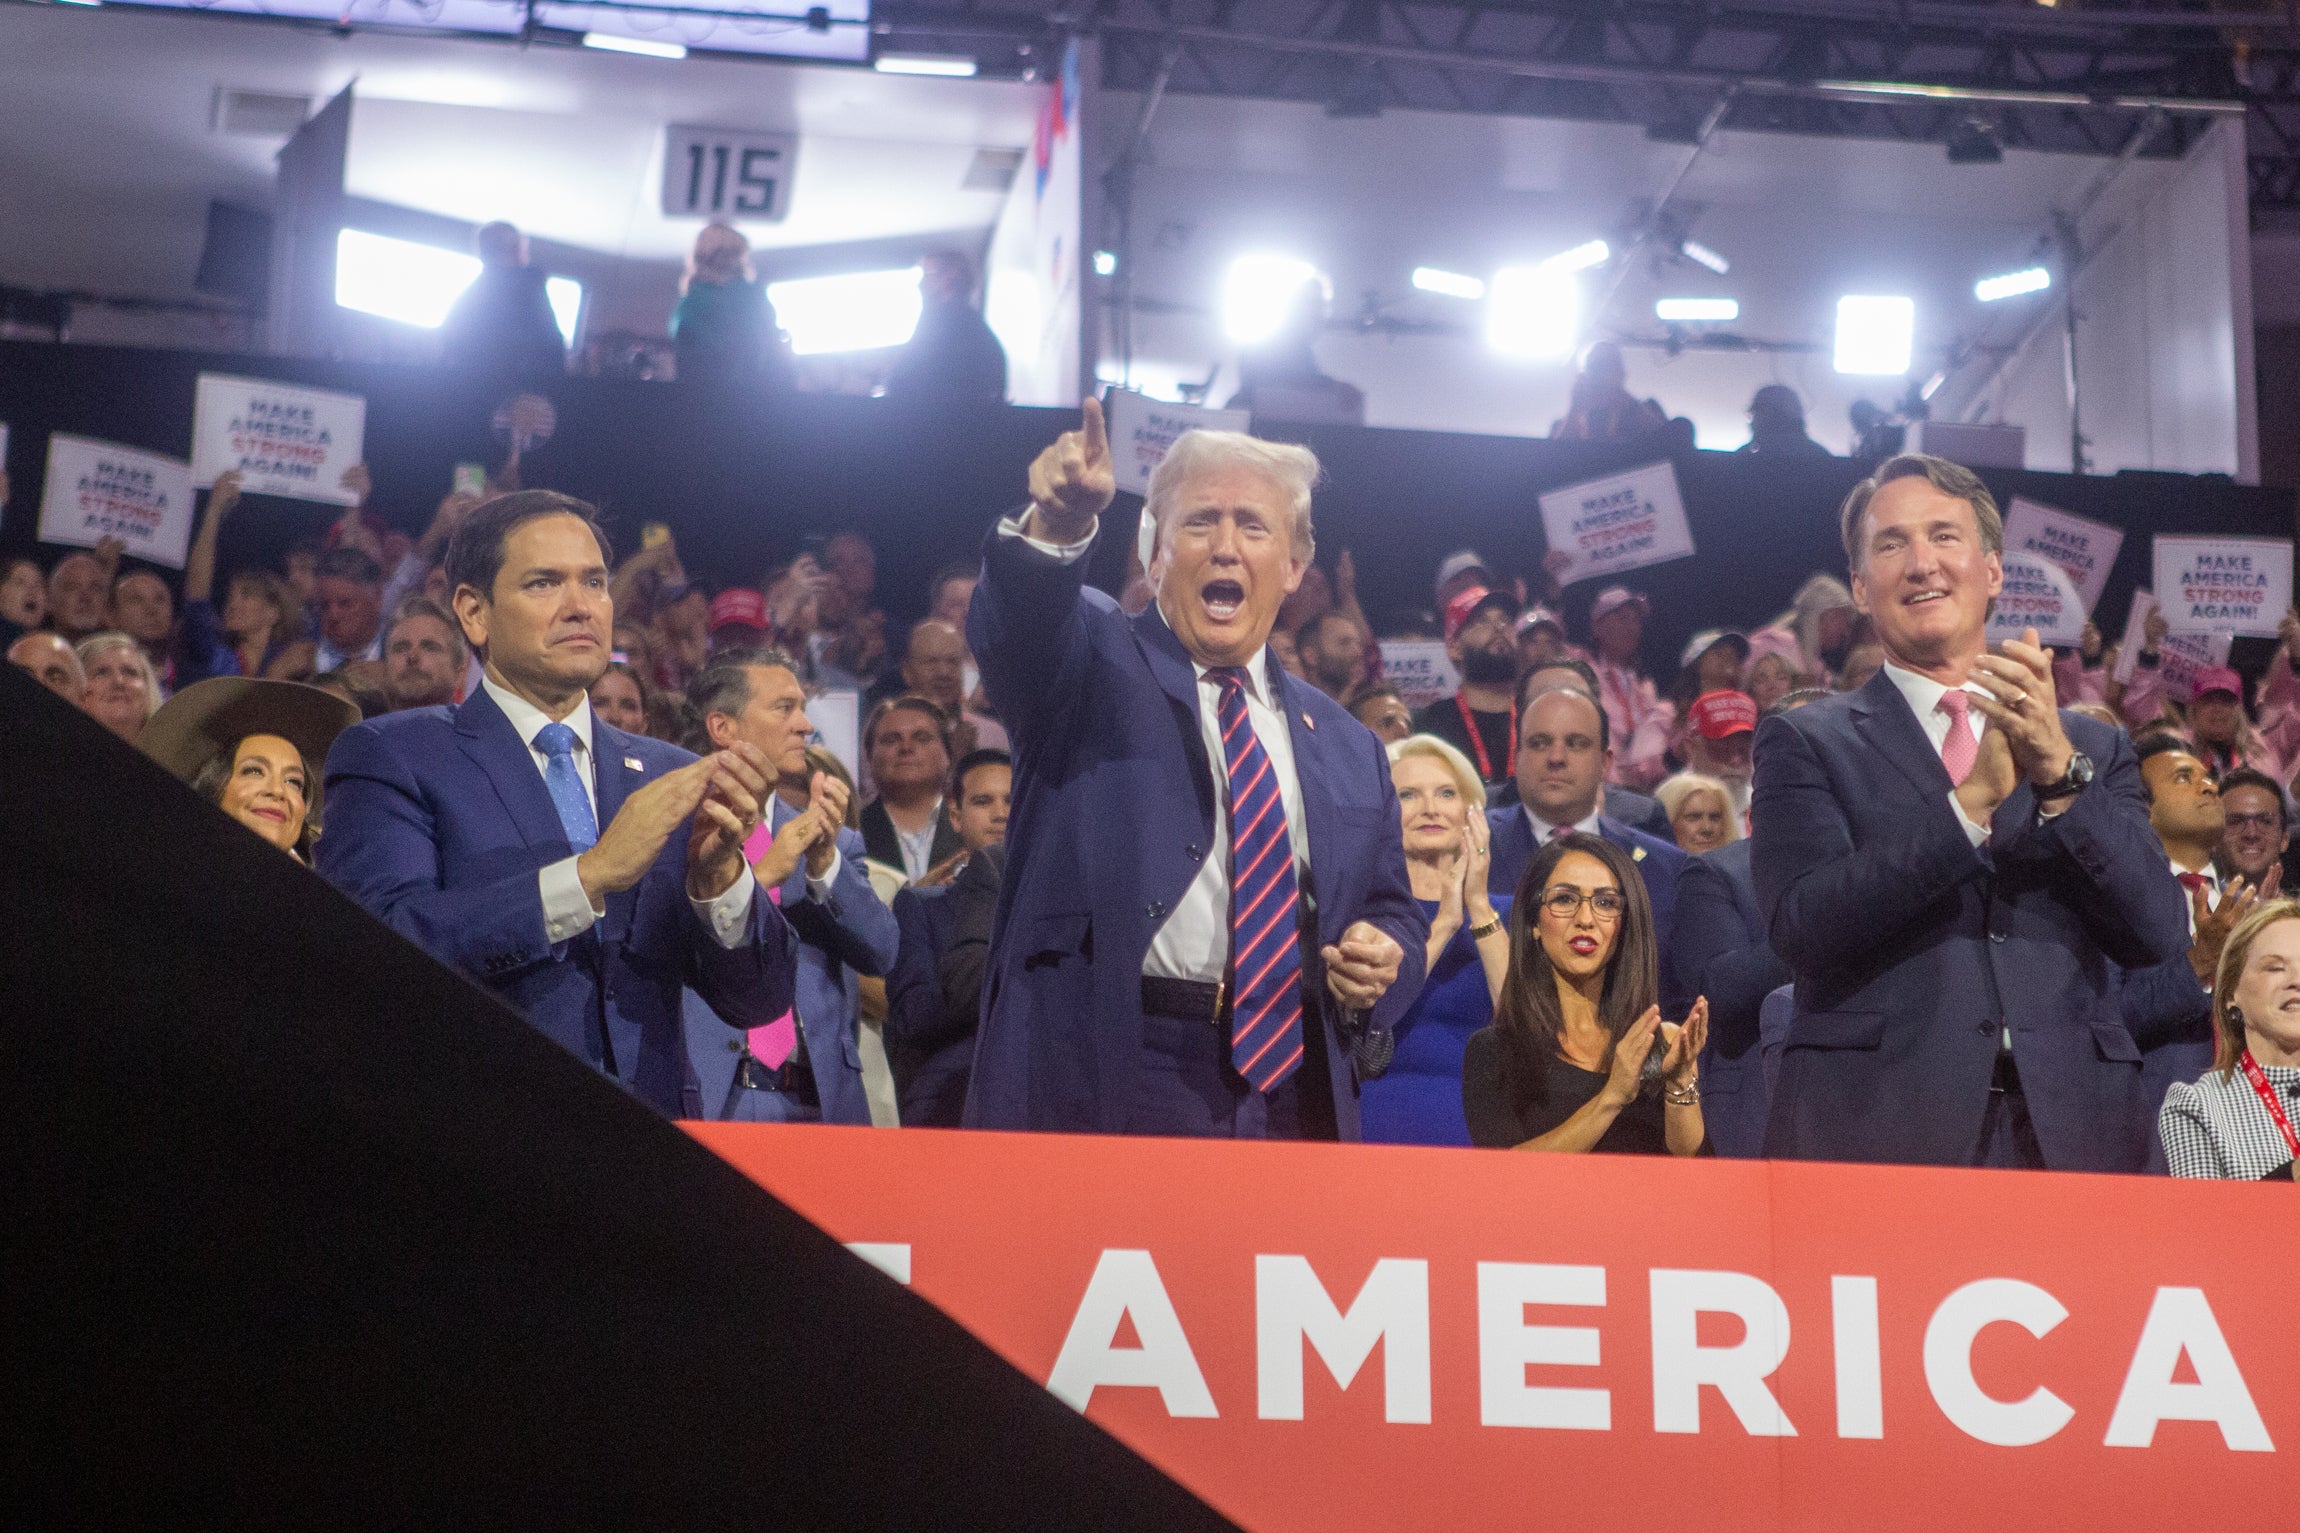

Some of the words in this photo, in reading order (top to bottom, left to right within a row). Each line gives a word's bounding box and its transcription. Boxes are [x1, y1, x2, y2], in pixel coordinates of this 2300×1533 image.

[686, 144, 780, 213] 115
[2197, 555, 2252, 571] MAKE
[2180, 572, 2268, 588] AMERICA
[2184, 588, 2265, 605] STRONG
[1045, 1248, 2276, 1453] AMERICA
